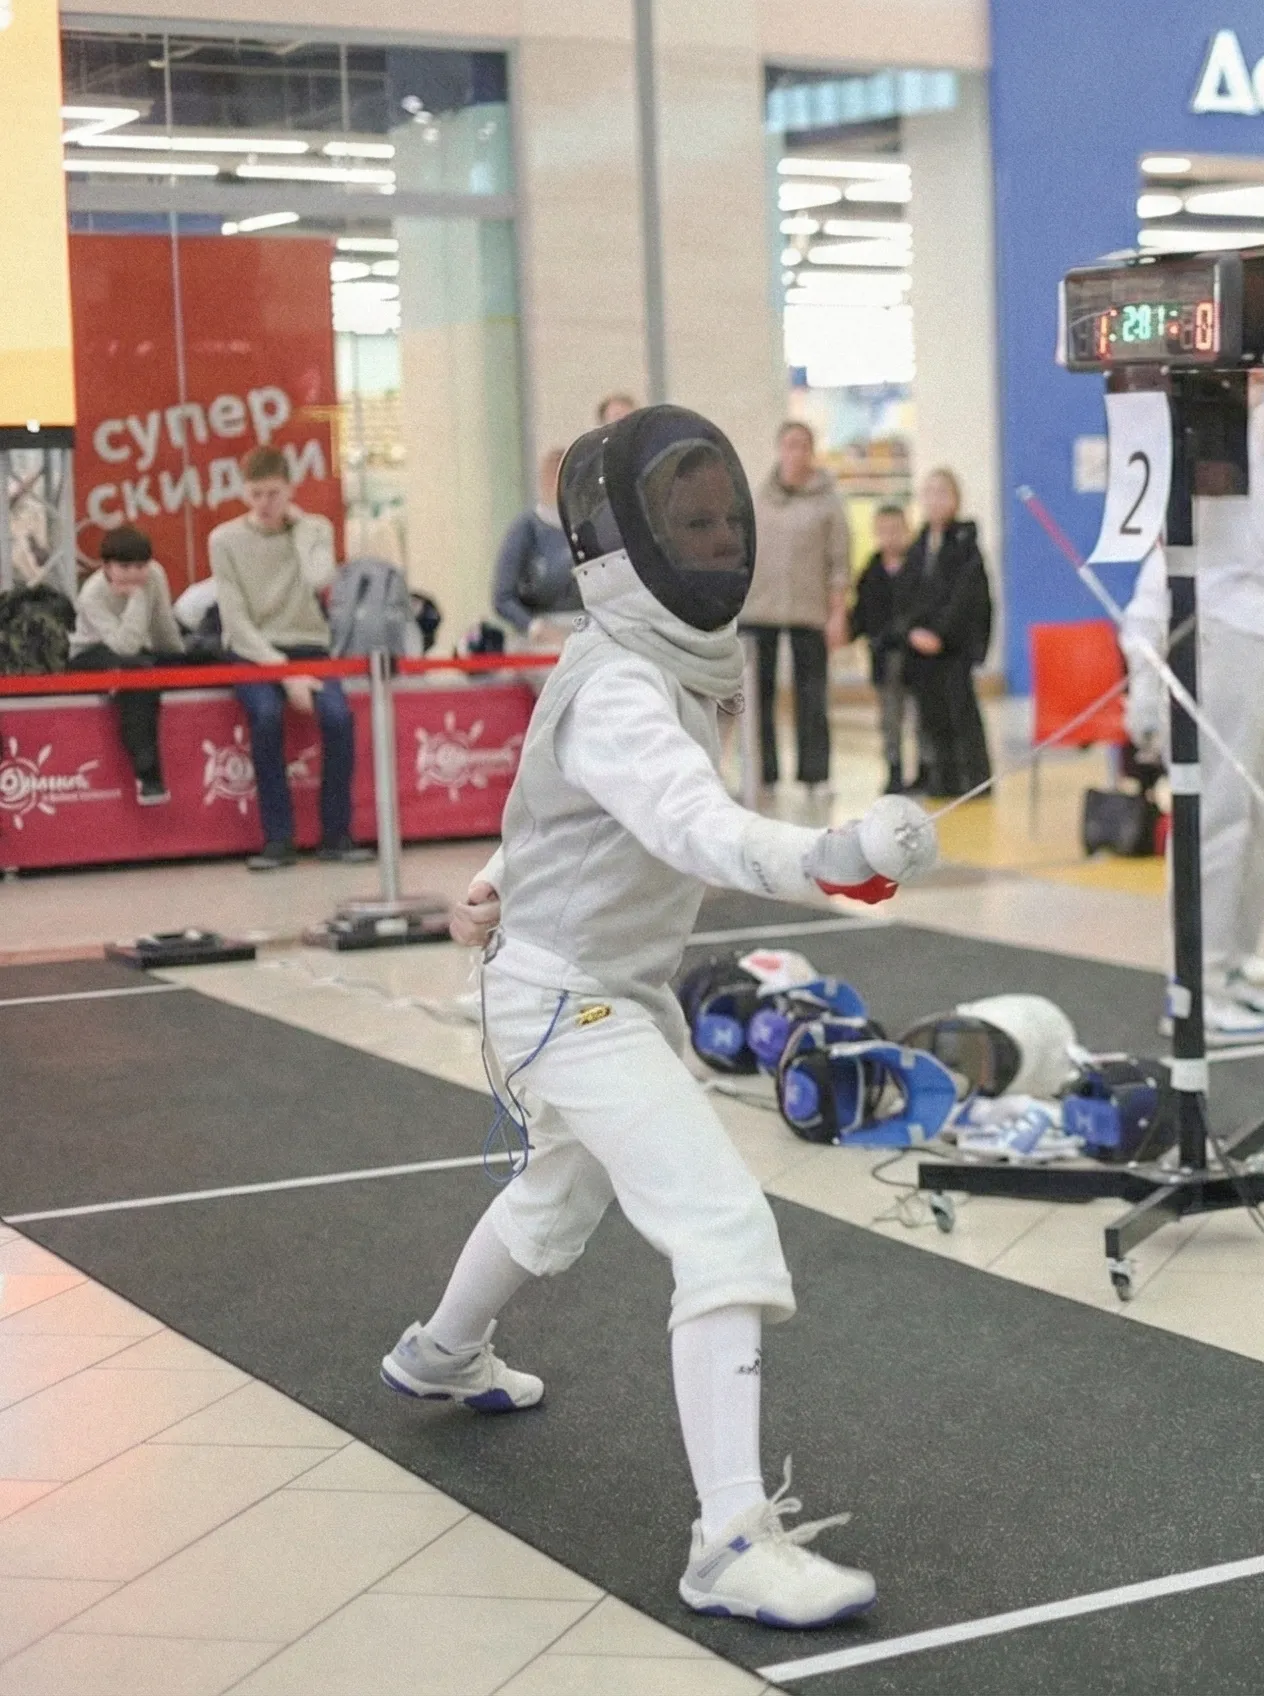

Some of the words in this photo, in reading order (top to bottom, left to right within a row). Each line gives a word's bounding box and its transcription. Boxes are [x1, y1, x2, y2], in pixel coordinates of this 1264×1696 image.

[92, 384, 293, 472] супер
[86, 437, 328, 532] скиди
[1119, 450, 1151, 535] 2
